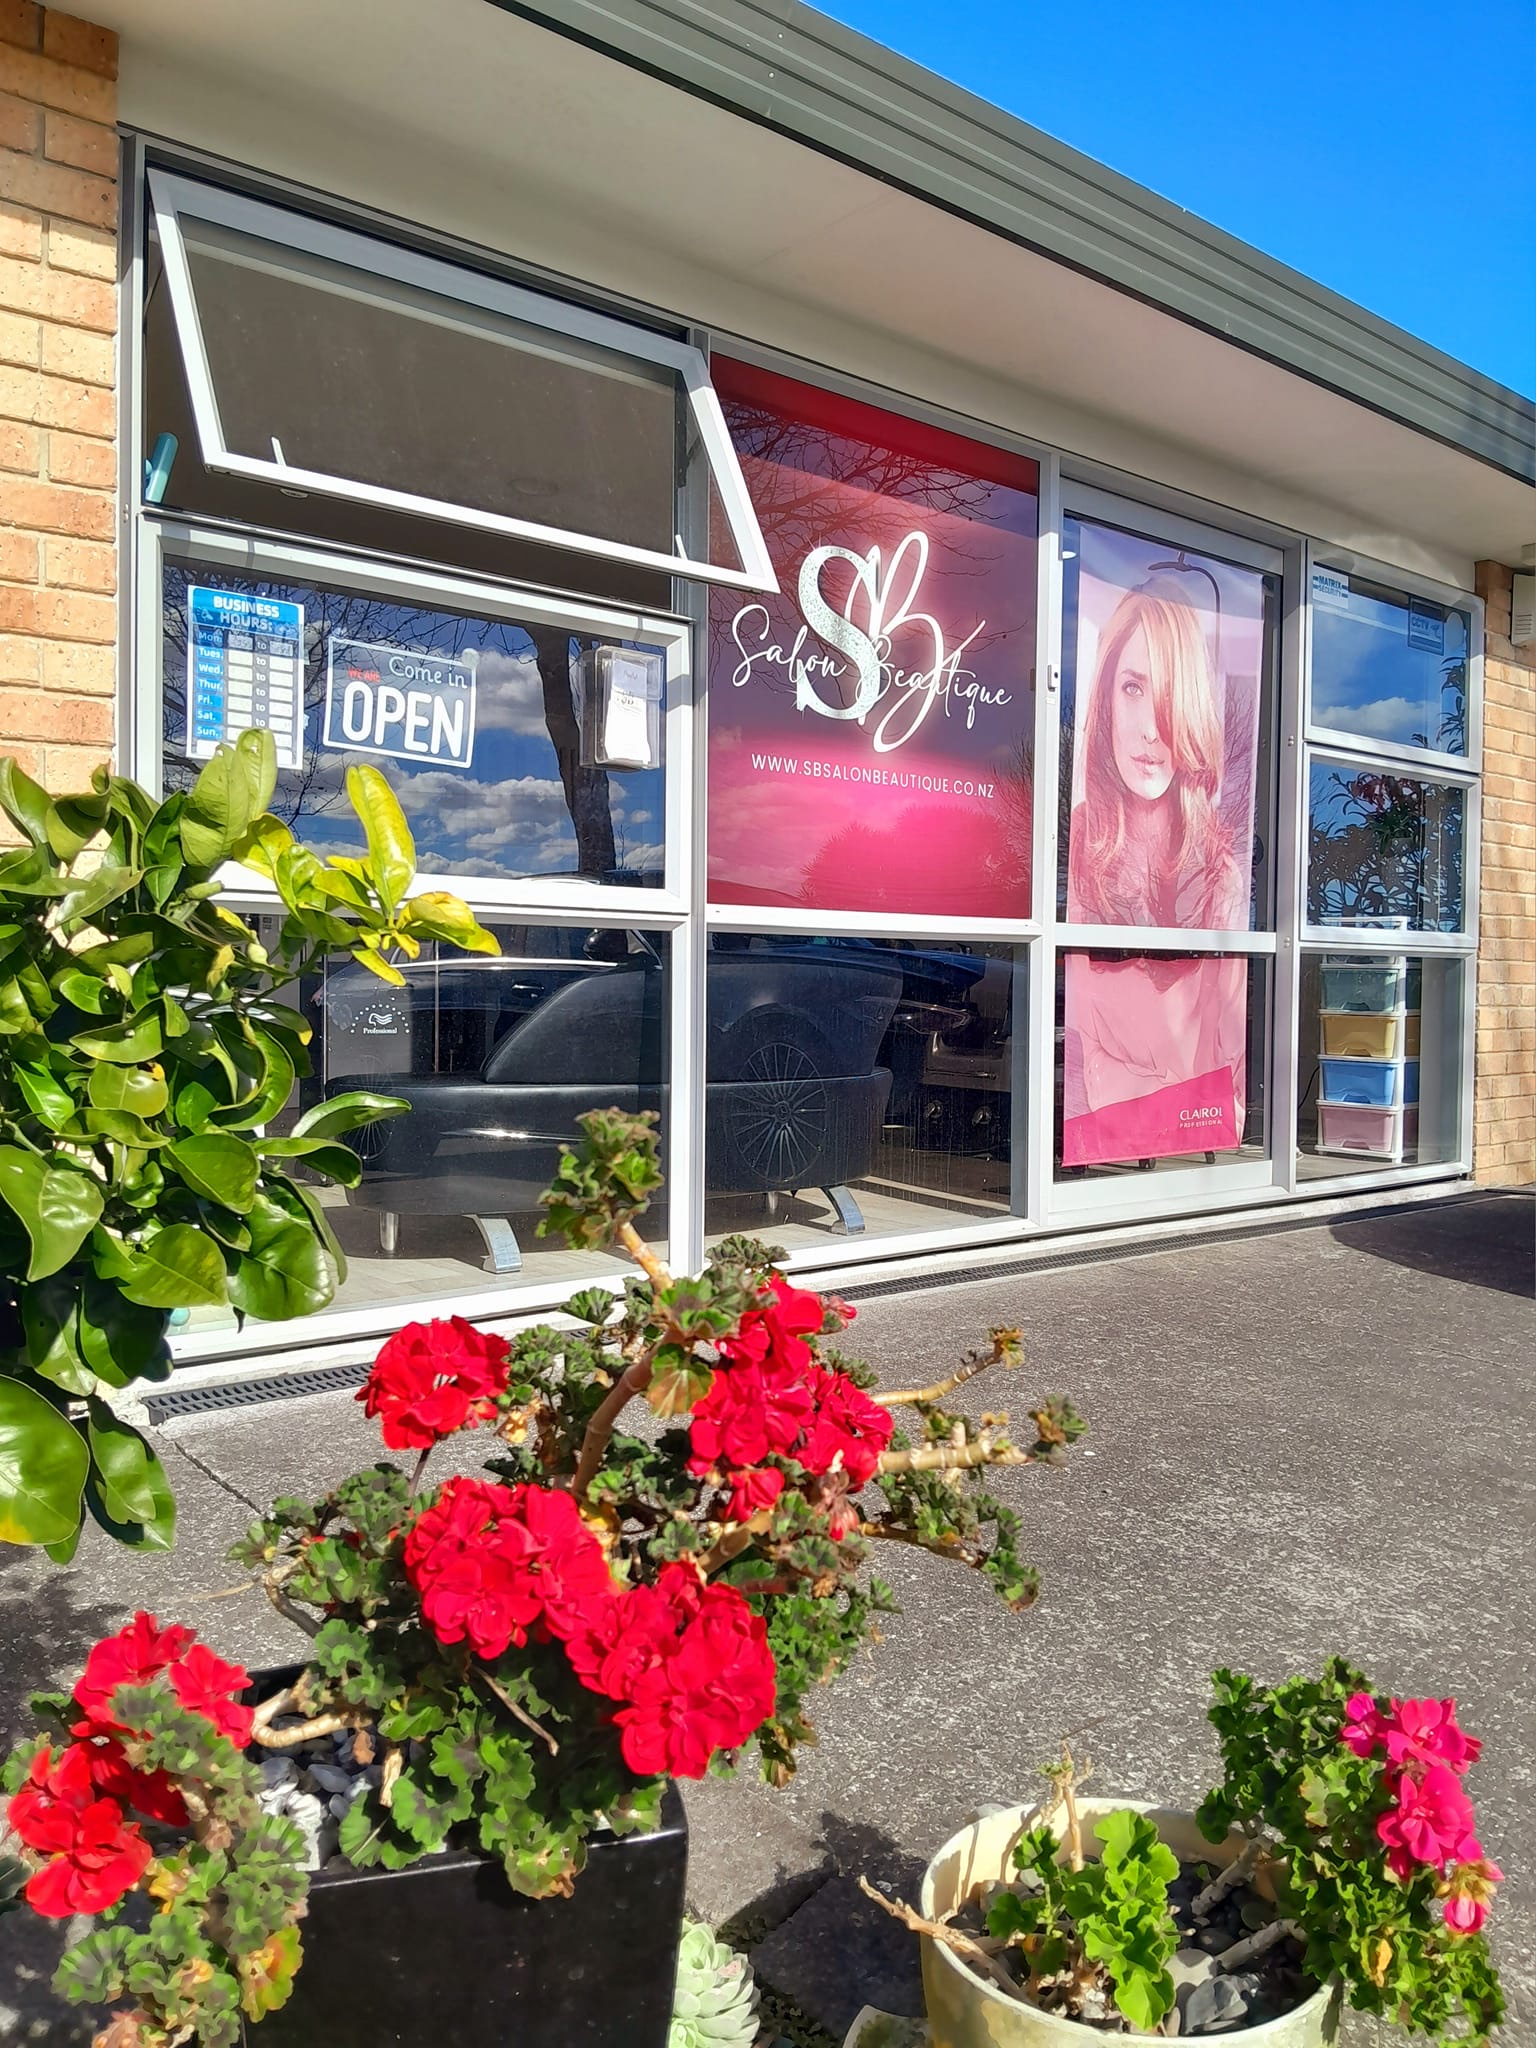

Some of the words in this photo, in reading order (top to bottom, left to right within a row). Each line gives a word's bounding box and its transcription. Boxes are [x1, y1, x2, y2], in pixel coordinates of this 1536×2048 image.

[1318, 575, 1342, 590] MATRIX
[213, 596, 280, 618] BUSINESS
[220, 612, 273, 632] HOURS:
[1412, 616, 1429, 630] CCTV
[198, 647, 224, 659] Tues.
[256, 657, 266, 666] to
[199, 664, 223, 675] Wed.
[256, 673, 266, 681] to
[389, 656, 442, 684] Come
[448, 667, 468, 689] in
[732, 604, 847, 687] Salon
[855, 620, 1012, 729] Beautique
[199, 679, 223, 690] Thur.
[256, 688, 266, 696] to
[197, 694, 213, 705] Fri.
[256, 703, 266, 711] to
[197, 711, 216, 721] Sat.
[256, 718, 266, 727] to
[342, 681, 464, 758] OPEN
[197, 727, 218, 737] Sun.
[751, 753, 995, 799] WWW.SBSALONBEAUTIQUE.CO.NZ
[363, 1027, 397, 1035] Professional
[1179, 1106, 1222, 1121] CLAIROL
